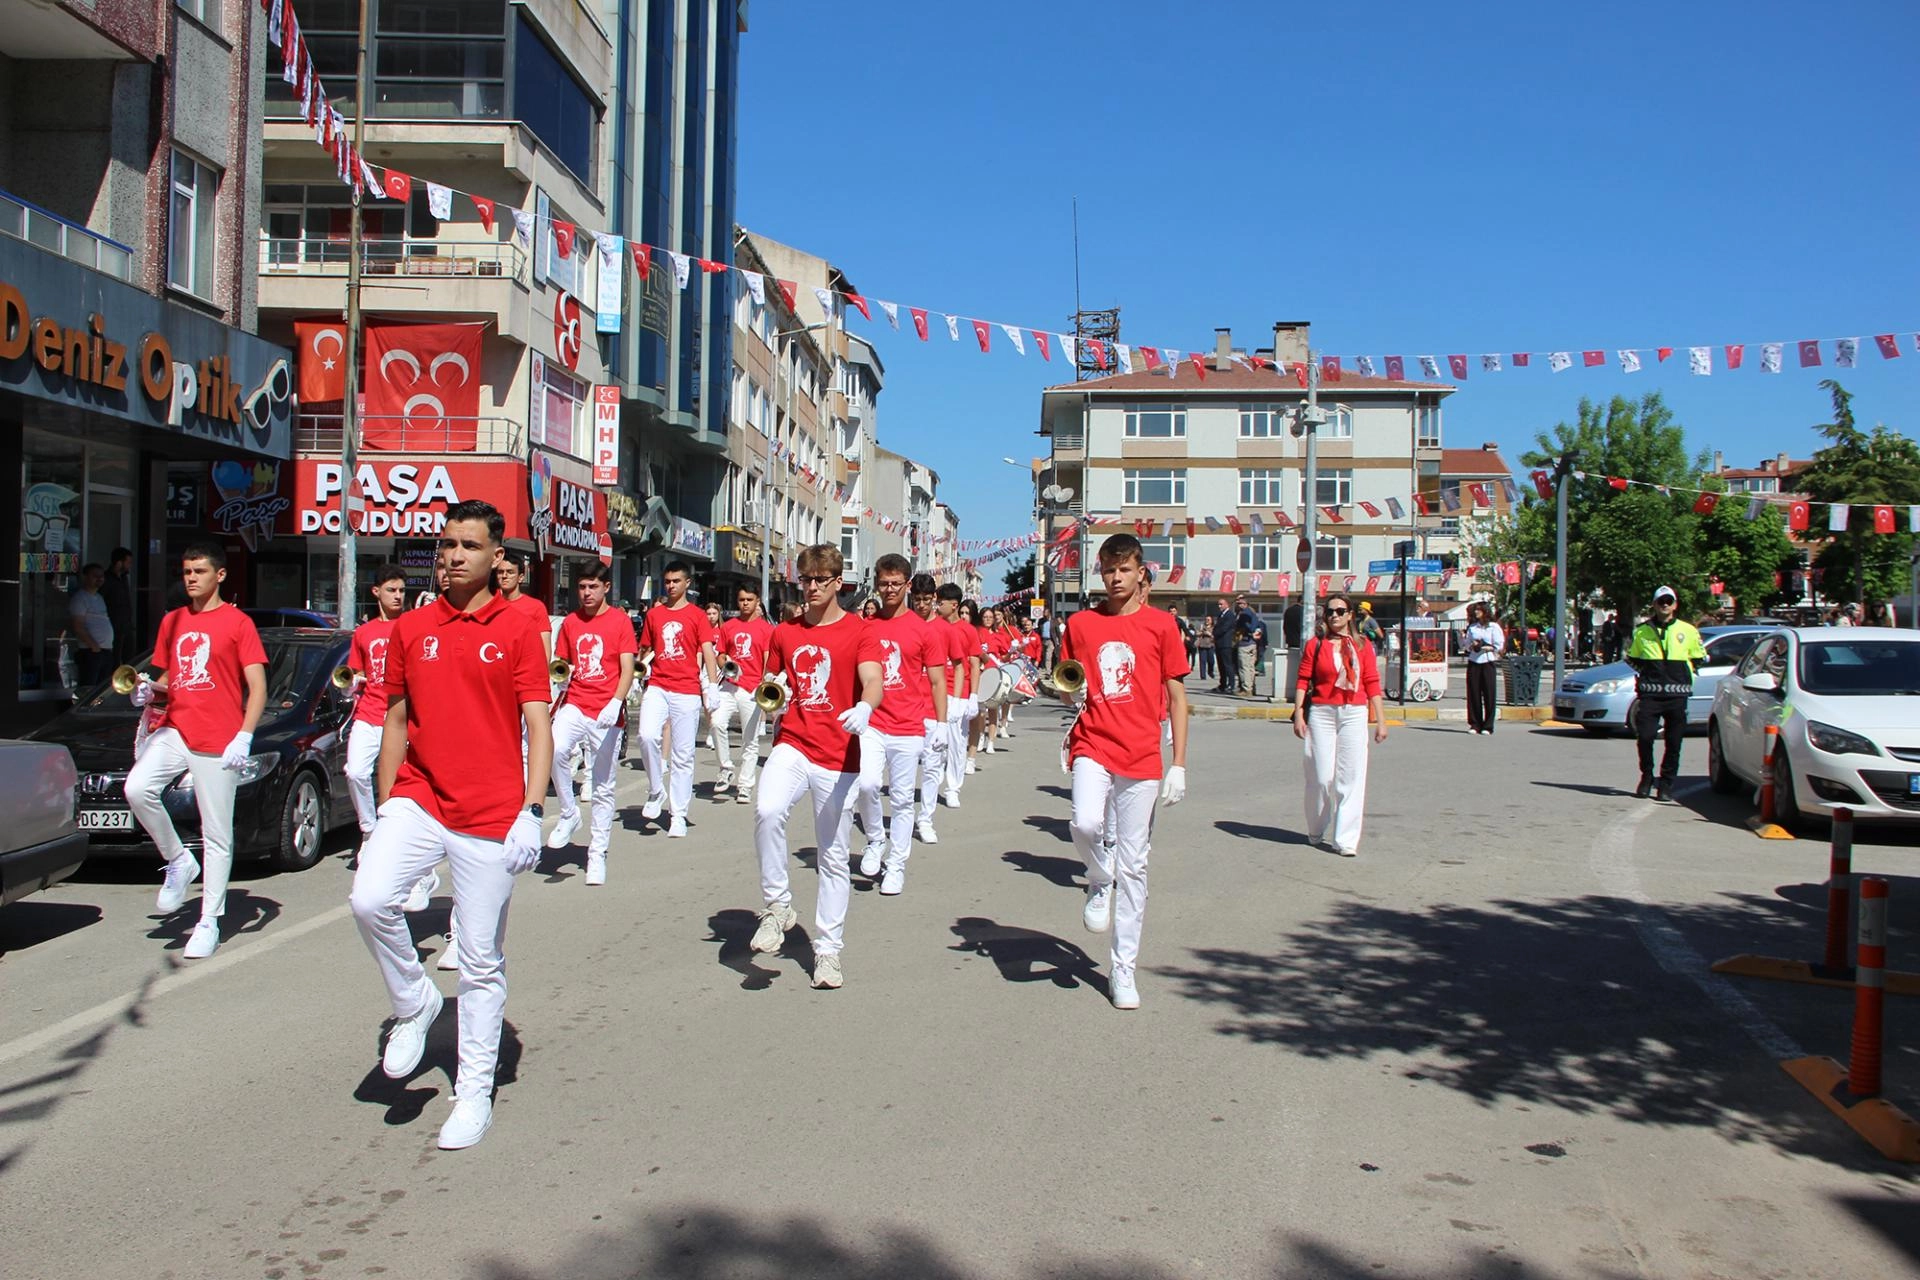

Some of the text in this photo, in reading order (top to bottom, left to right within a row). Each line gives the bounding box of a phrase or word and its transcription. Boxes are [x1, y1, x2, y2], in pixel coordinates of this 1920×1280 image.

[0, 283, 243, 426] Deniz Optik
[316, 463, 460, 512] PAŞA
[559, 481, 595, 529] PAŞA
[555, 522, 600, 552] DONDURMA
[102, 812, 129, 827] 237
